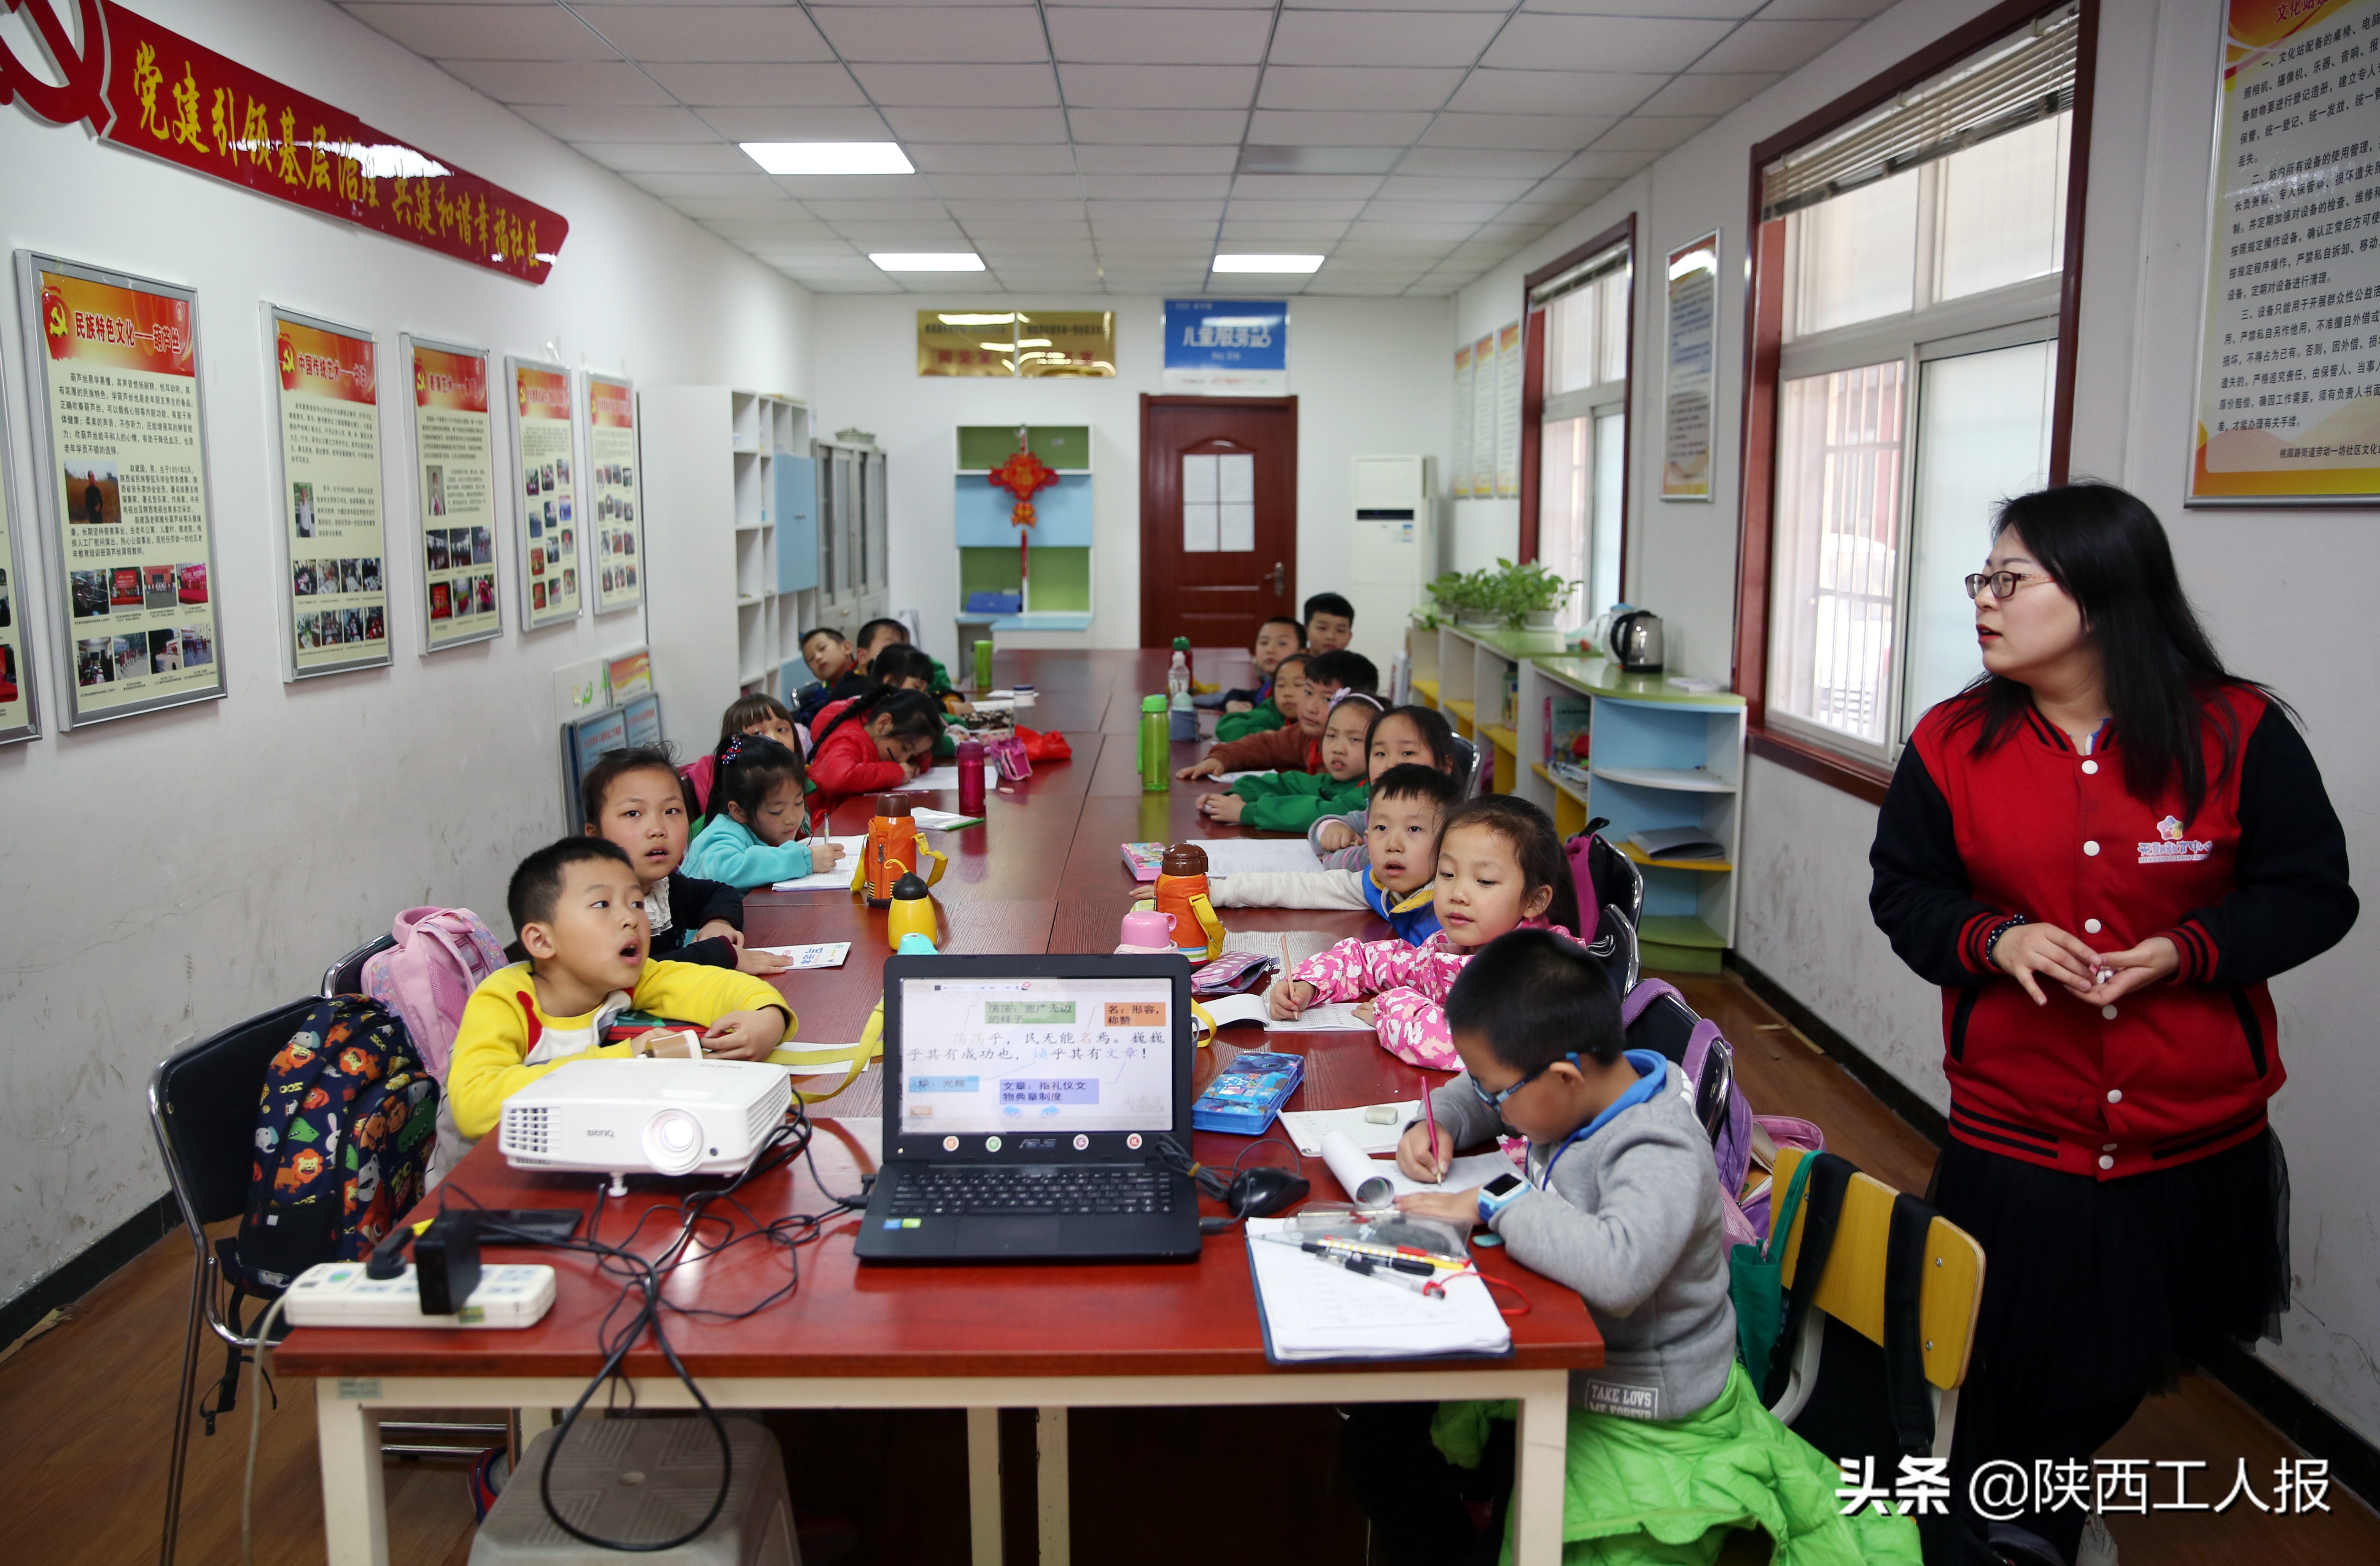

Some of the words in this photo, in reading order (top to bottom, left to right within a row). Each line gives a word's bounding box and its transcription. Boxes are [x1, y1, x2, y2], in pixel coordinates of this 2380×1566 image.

[2275, 0, 2328, 24] 文化站
[2252, 140, 2380, 185] 二、站内所有设备的使用管理，
[1019, 1138, 1056, 1149] ASUS
[1591, 1385, 1620, 1403] TAKE
[1622, 1389, 1651, 1408] LOVS
